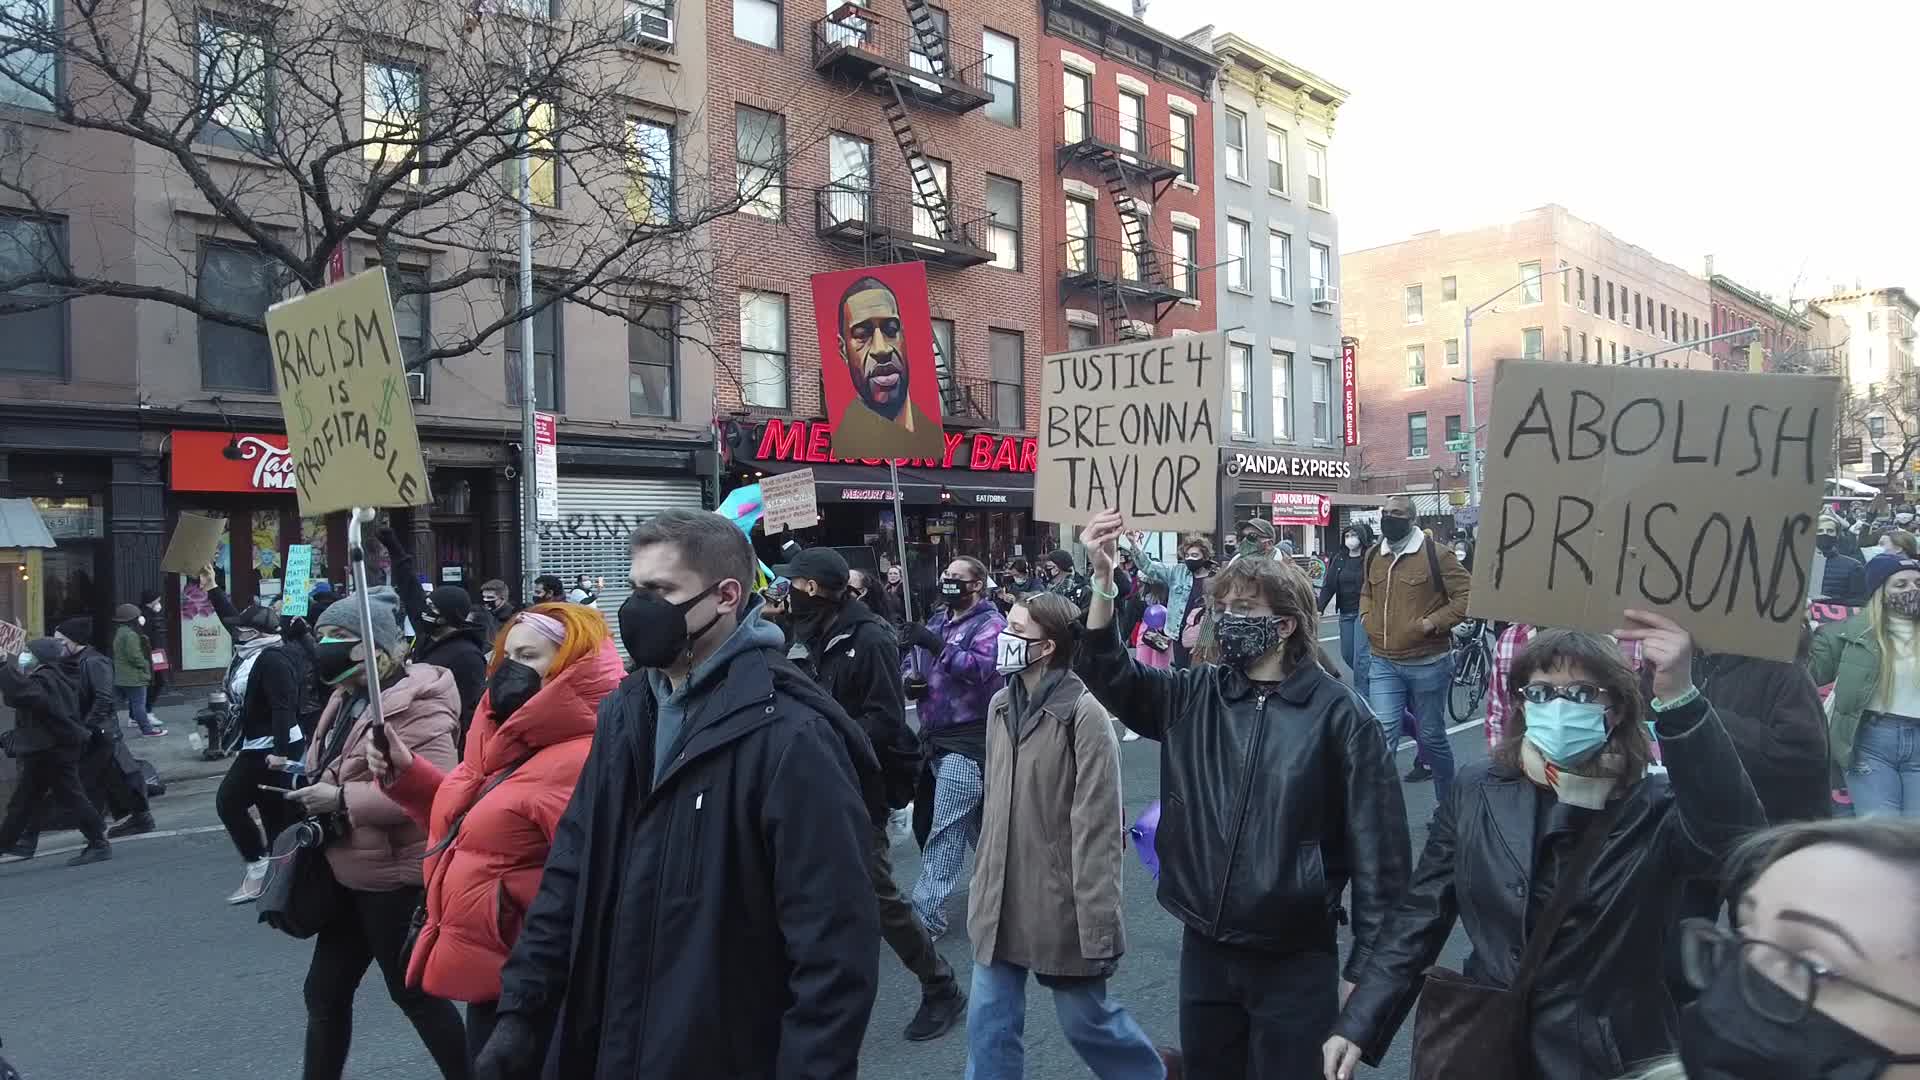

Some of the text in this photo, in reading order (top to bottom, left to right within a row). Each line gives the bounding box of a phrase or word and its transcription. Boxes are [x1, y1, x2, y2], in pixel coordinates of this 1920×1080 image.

[1048, 341, 1213, 395] JUSTICE 4
[1345, 349, 1353, 387] PANDA
[328, 380, 351, 405] IS
[1048, 398, 1214, 449] BREONNA
[1503, 387, 1819, 485] ABOLISH
[295, 410, 418, 505] PROFITABLE
[969, 434, 1038, 473] BAR
[1236, 454, 1351, 478] PANDA EXPRESS
[842, 489, 884, 501] MERCURY
[976, 494, 1007, 503] EAT/DRINK
[1053, 454, 1201, 518] TAYLOR
[1274, 493, 1320, 505] JOIN OUR TEAM
[1494, 492, 1812, 623] PRISONS
